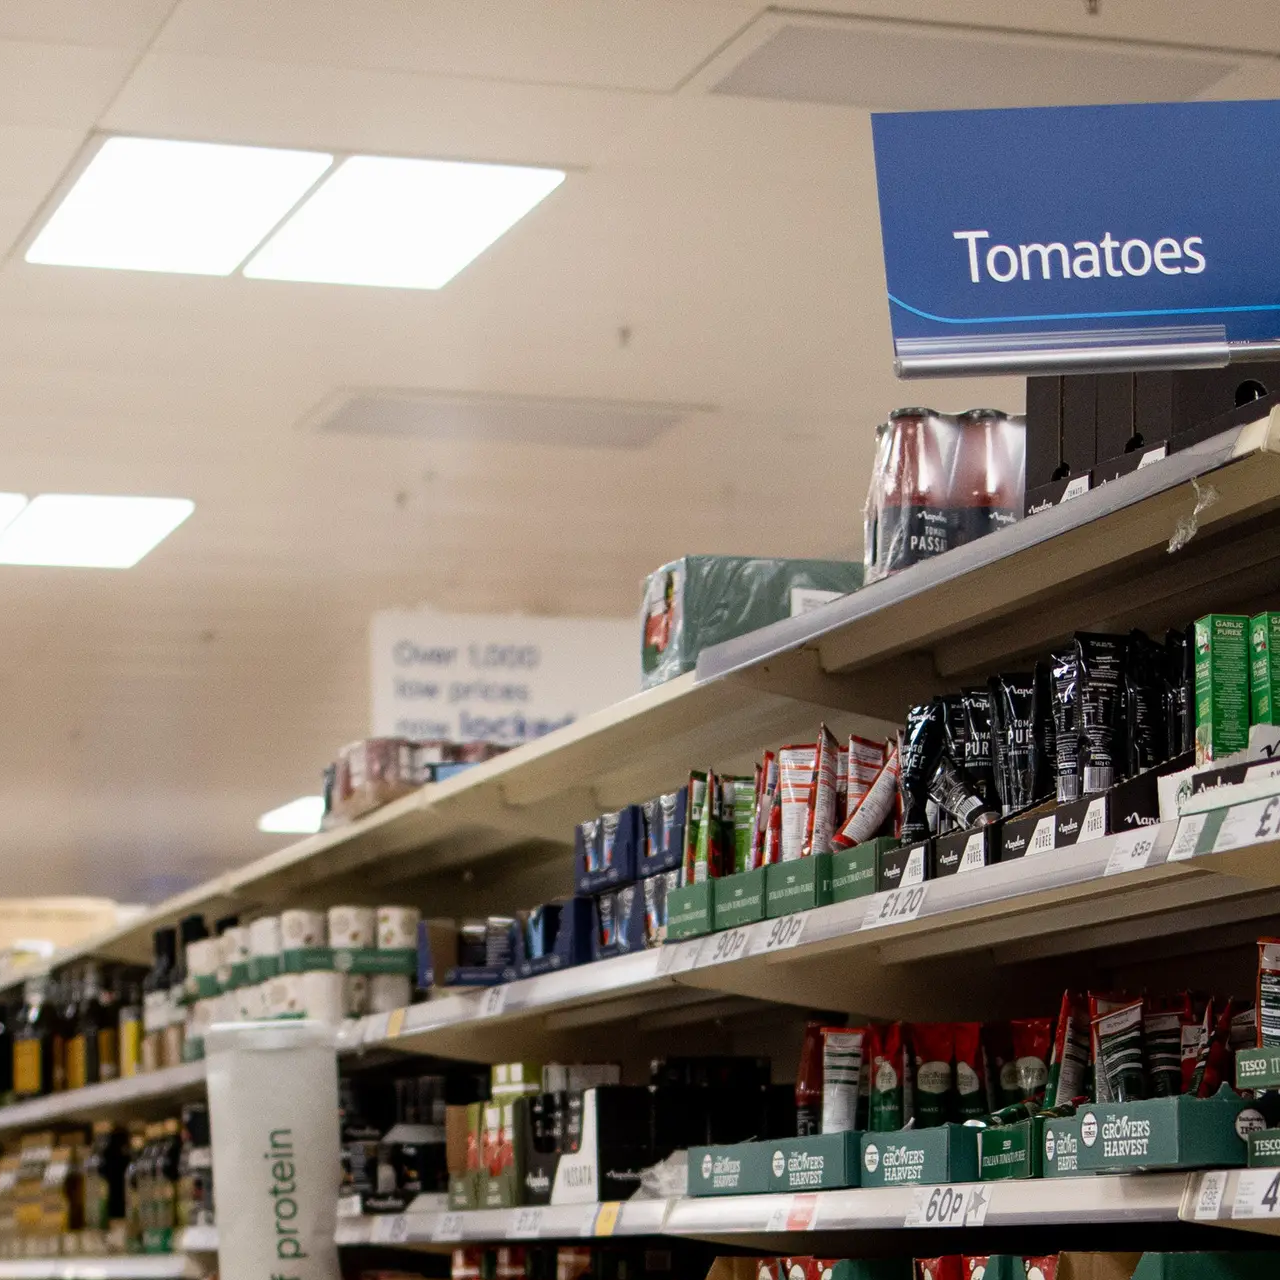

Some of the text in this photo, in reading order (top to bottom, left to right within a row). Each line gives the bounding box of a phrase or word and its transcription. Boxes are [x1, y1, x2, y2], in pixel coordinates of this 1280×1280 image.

[954, 230, 1206, 285] Tomatoes
[1216, 620, 1244, 629] GARLIC
[1216, 628, 1242, 636] PUREE
[1131, 840, 1152, 858] 85p
[878, 886, 925, 919] £1.20
[767, 916, 800, 948] 90p
[1240, 1060, 1266, 1072] TESCO
[1102, 1116, 1150, 1140] GROWER'S
[1104, 1139, 1149, 1157] HARVEST
[1254, 1139, 1280, 1151] TESCO
[883, 1146, 924, 1166] GROWER'S
[884, 1165, 922, 1181] HARVEST
[264, 1127, 307, 1262] protein
[925, 1187, 964, 1224] 60p
